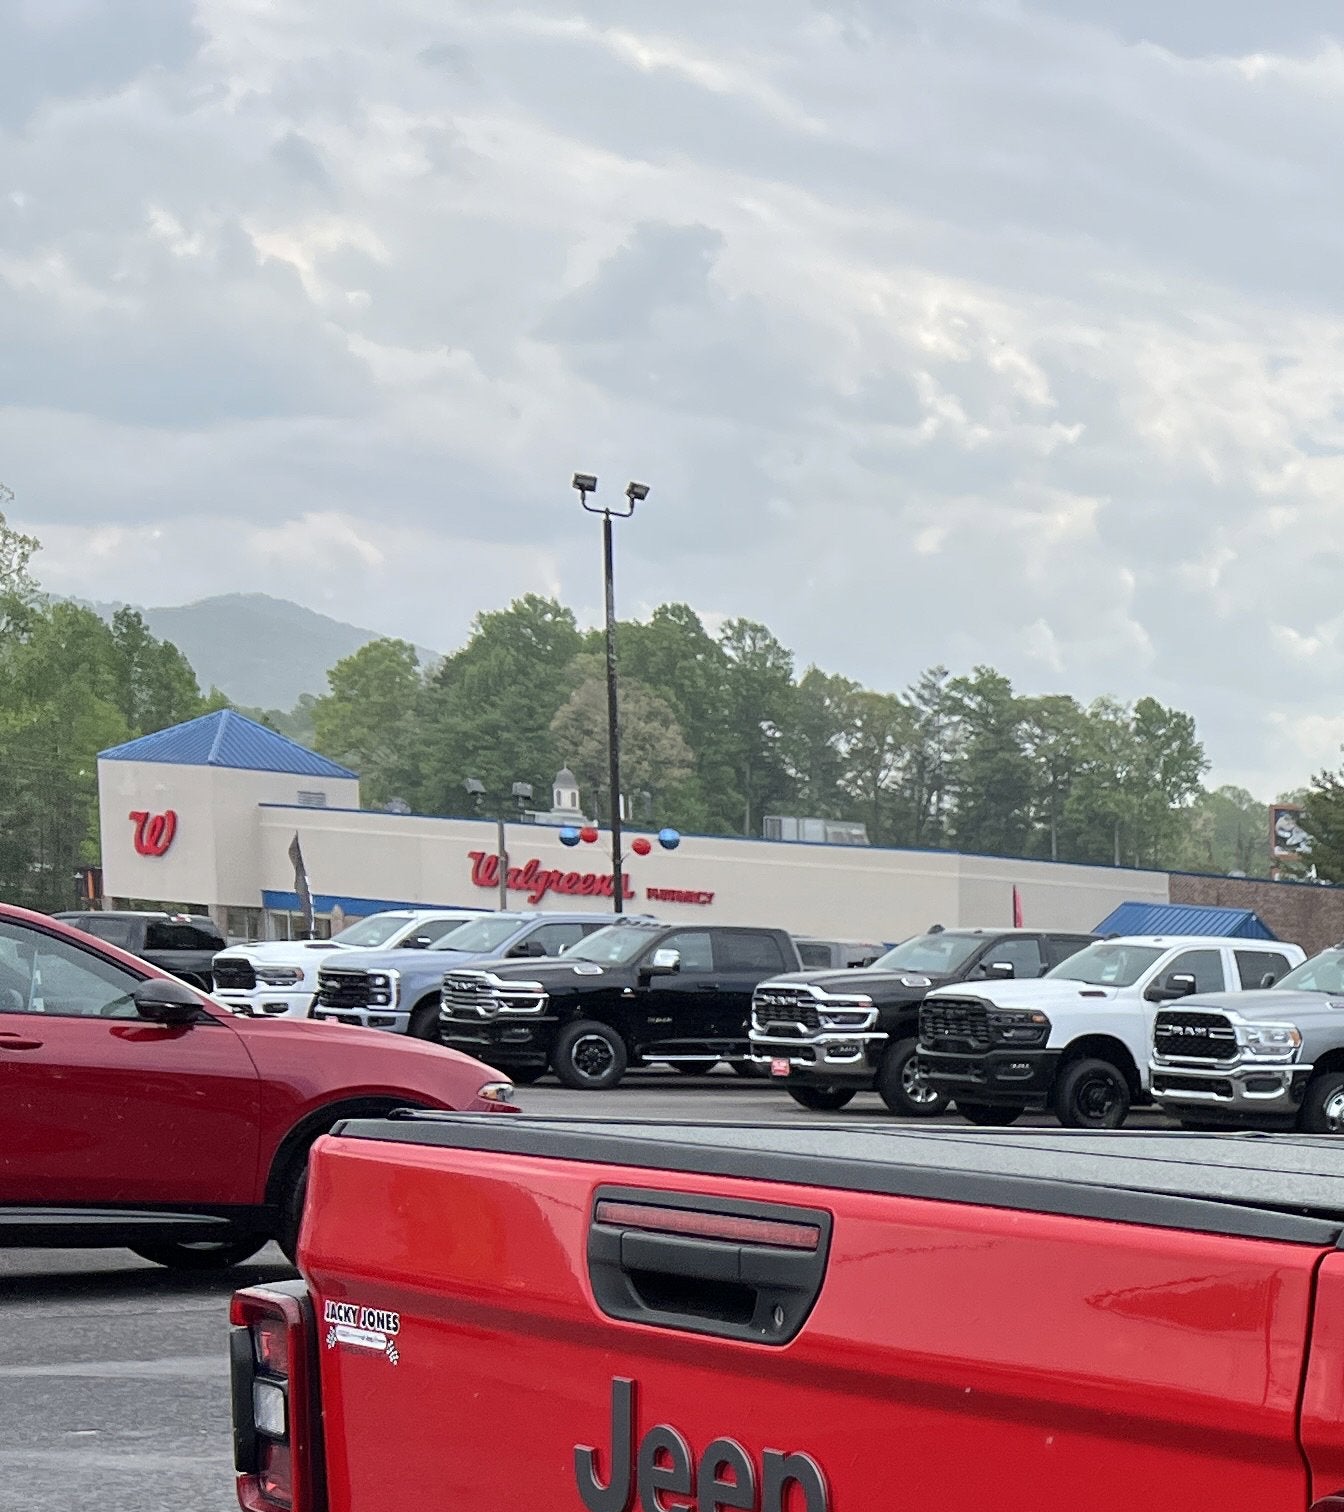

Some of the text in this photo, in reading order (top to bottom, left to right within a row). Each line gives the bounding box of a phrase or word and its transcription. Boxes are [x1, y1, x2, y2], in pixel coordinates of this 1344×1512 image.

[128, 810, 177, 857] W
[468, 851, 635, 904] Walgreens
[325, 1301, 399, 1335] JACKY JONES
